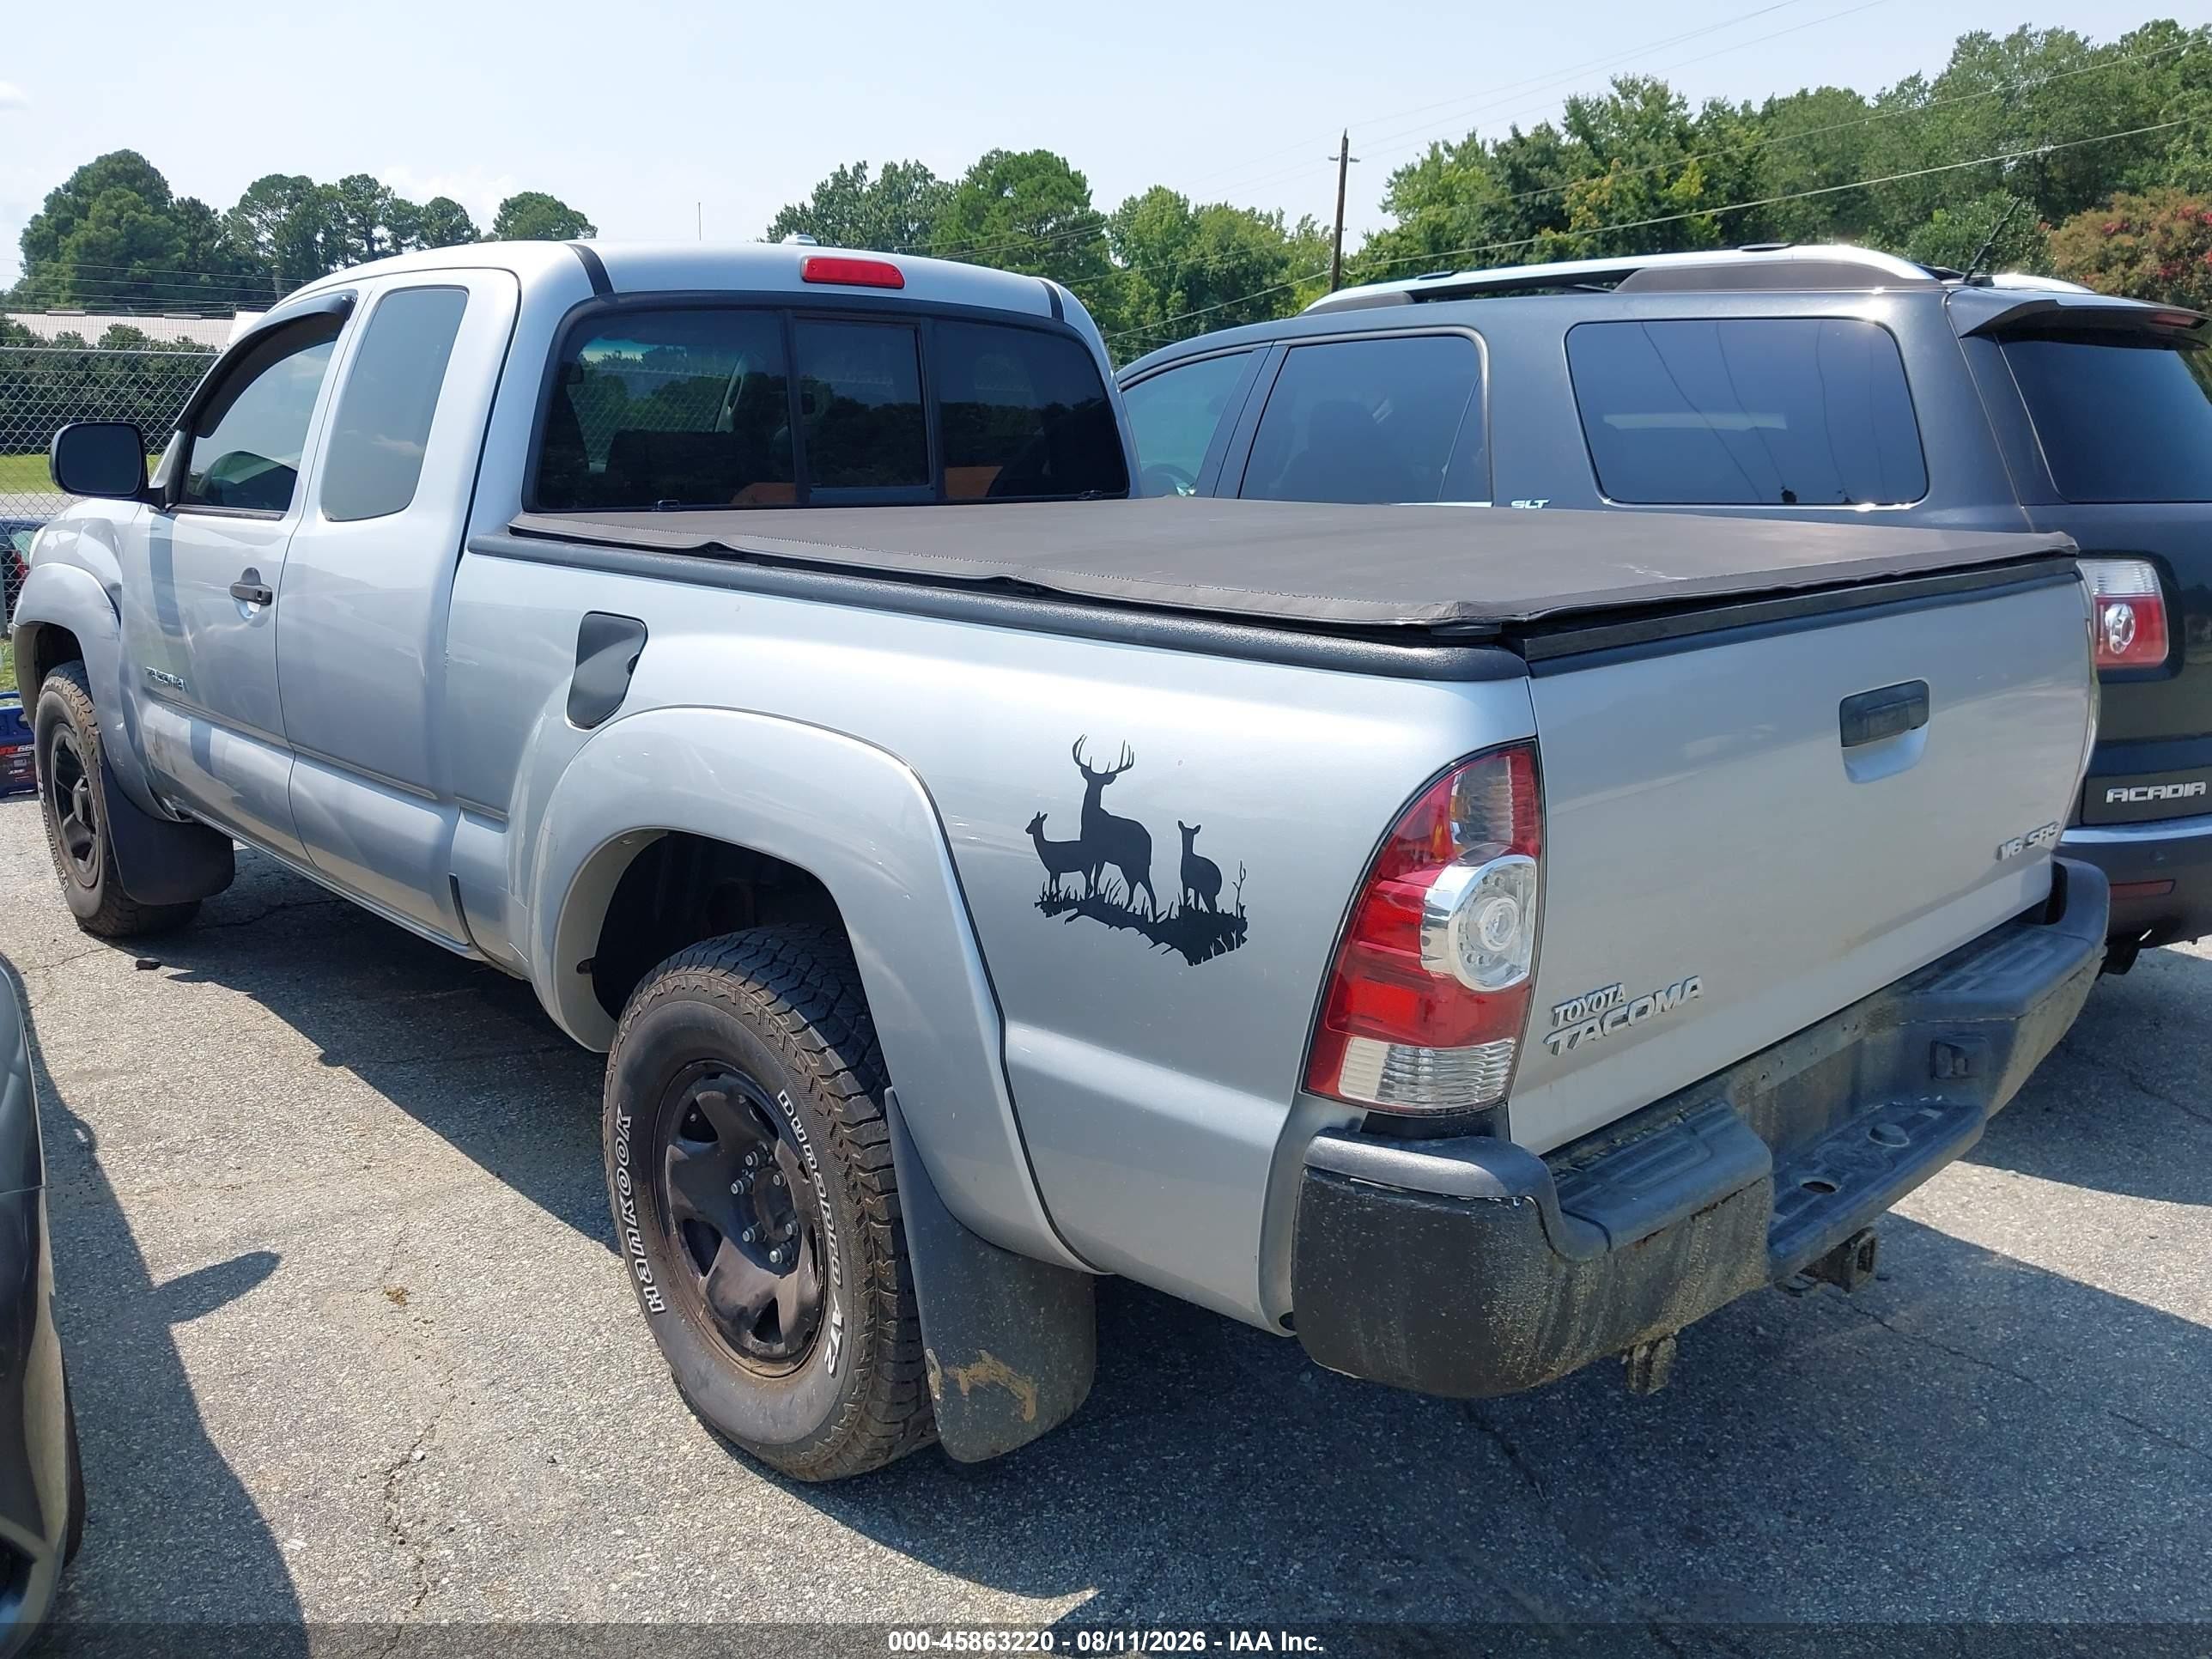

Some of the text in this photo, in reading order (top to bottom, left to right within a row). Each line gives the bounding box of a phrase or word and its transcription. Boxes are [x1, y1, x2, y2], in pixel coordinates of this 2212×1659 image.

[1510, 499, 1550, 509] SLT
[2106, 781, 2207, 804] ACADIA
[1543, 975, 1705, 1056] TACOMA
[1552, 982, 1627, 1028] TOYOTA
[824, 1291, 845, 1376] AT2
